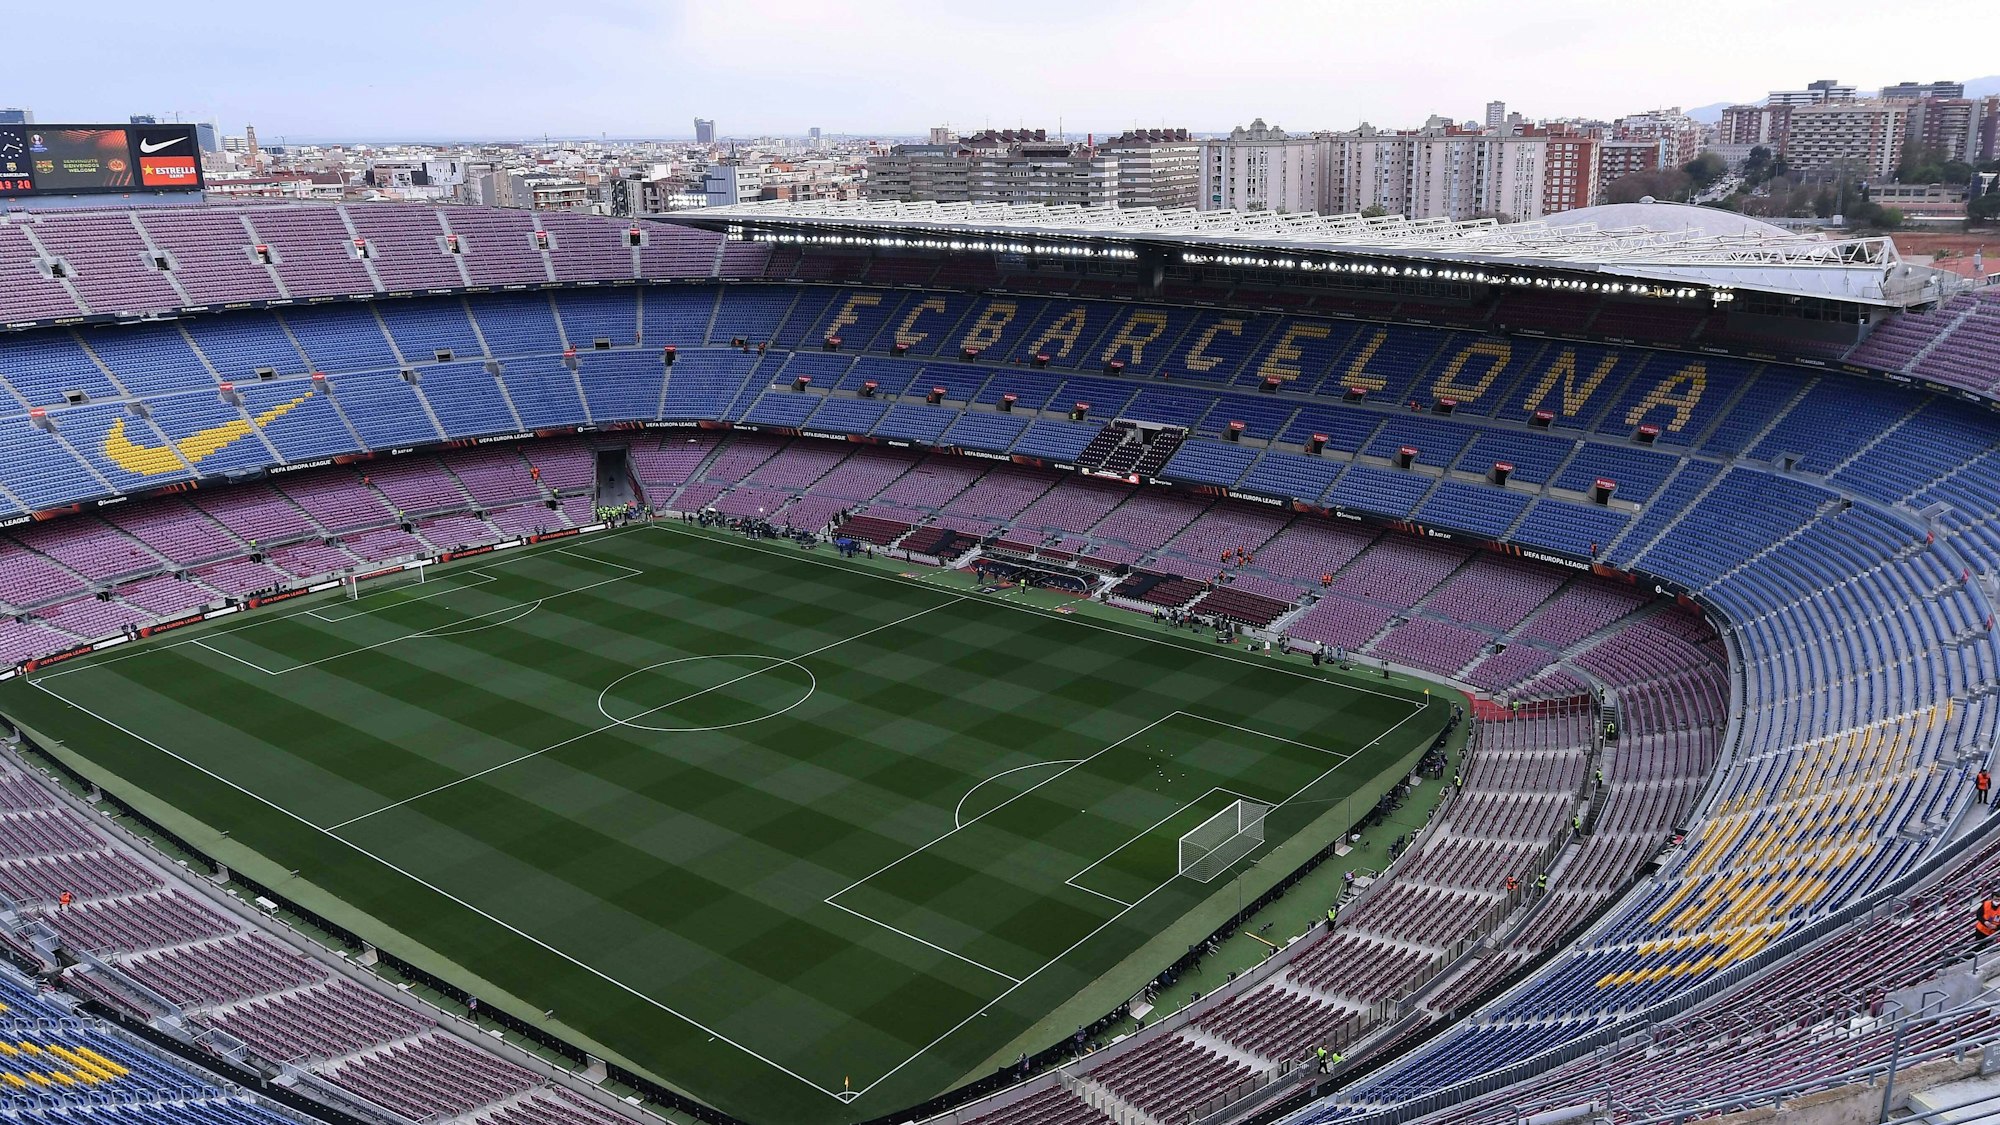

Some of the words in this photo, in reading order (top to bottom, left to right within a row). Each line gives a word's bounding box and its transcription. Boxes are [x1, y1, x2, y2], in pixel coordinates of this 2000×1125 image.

[824, 292, 946, 345] FC
[960, 299, 1709, 432] BARCELONA
[286, 463, 309, 471] EUROPA
[309, 459, 331, 468] LEAGUE
[1243, 494, 1262, 502] EUROPA
[1262, 497, 1281, 506] LEAGUE
[4, 515, 30, 527] LEAGUE
[1523, 550, 1540, 559] UEFA
[1540, 554, 1564, 565] EUROPA
[1565, 559, 1589, 571] LEAGUE
[274, 593, 290, 601] EUROPA
[290, 588, 307, 596] LEAGUE
[167, 620, 185, 628] EUROPA
[185, 615, 203, 624] LEAGUE
[40, 658, 54, 666] UEFA
[54, 652, 72, 661] EUROPA
[72, 646, 91, 655] LEAGUE
